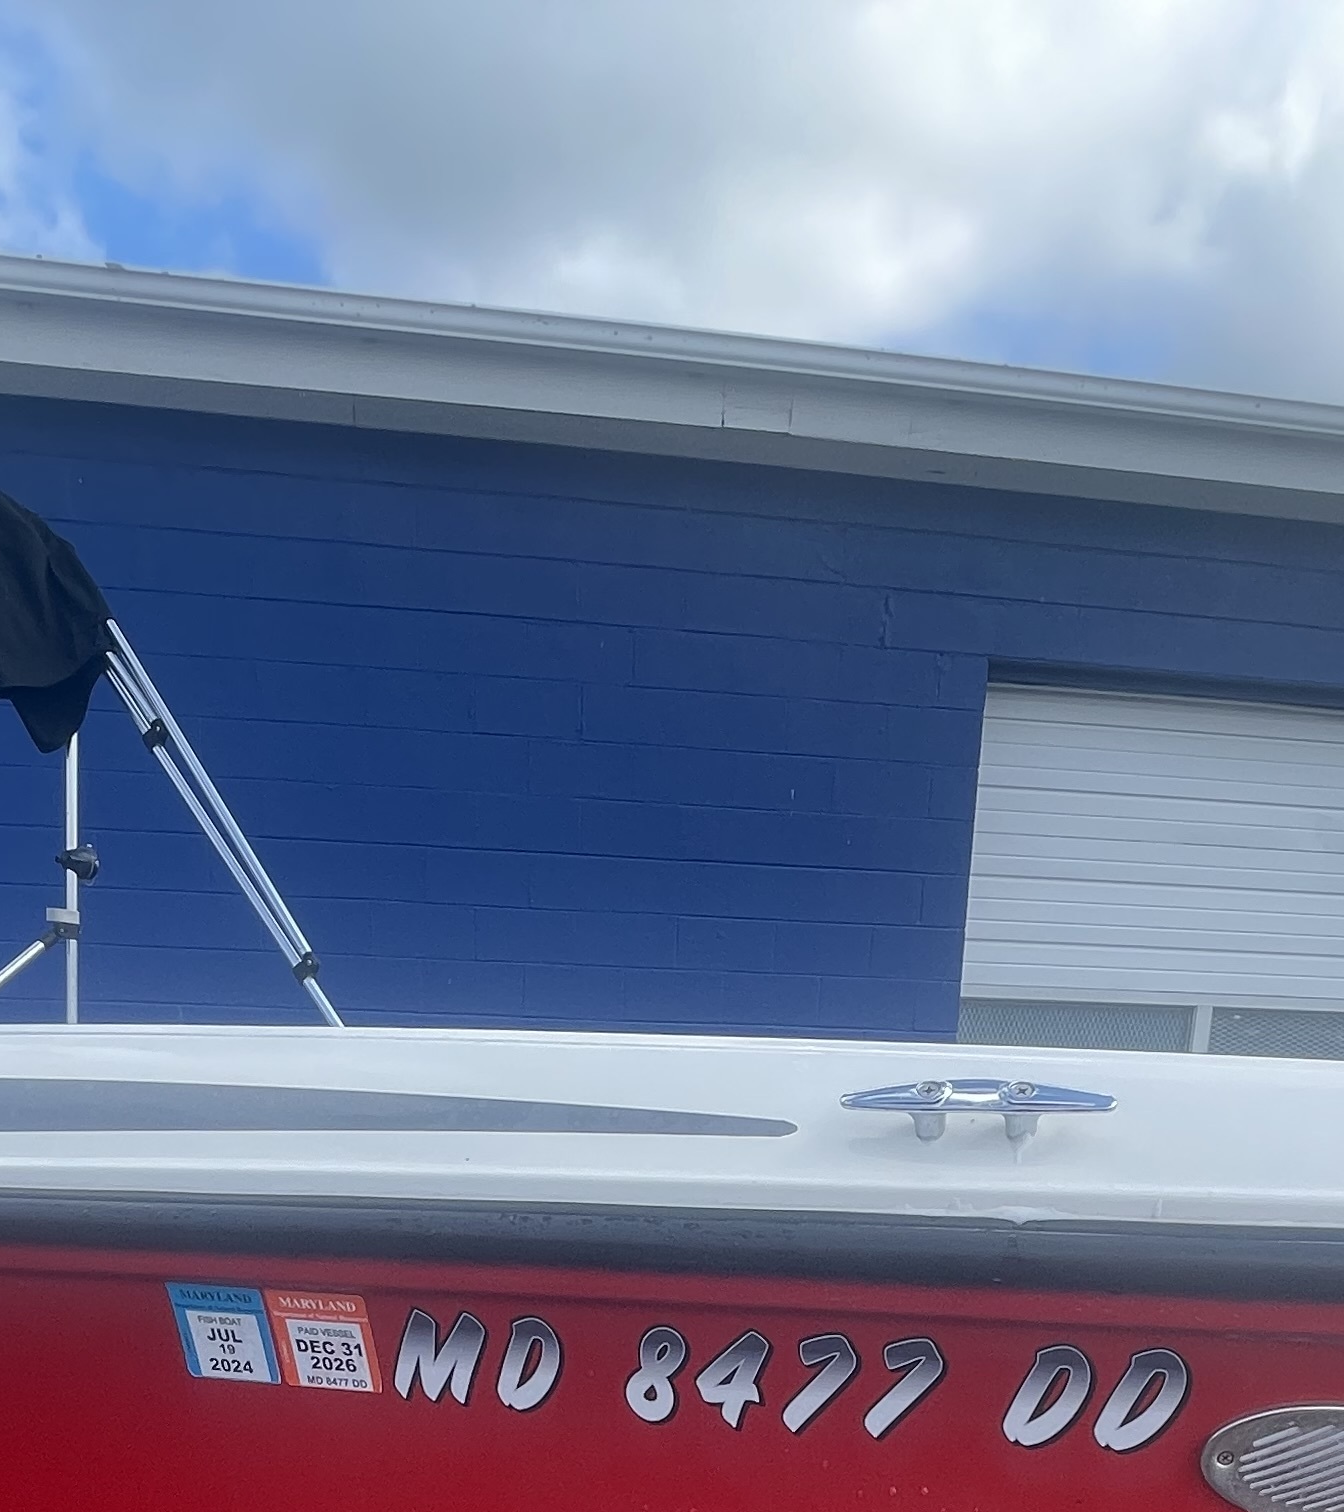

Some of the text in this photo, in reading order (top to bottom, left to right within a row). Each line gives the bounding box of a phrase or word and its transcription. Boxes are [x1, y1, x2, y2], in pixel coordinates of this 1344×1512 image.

[179, 1290, 252, 1303] MARYLAND
[278, 1297, 357, 1312] MARYLAND
[197, 1315, 242, 1326] FISH BOAT
[207, 1328, 243, 1343] JUL
[297, 1326, 356, 1339] PAID VESSEL
[219, 1344, 235, 1354] 19
[296, 1339, 336, 1355] DEC
[340, 1342, 364, 1357] 31
[209, 1358, 254, 1374] 2024
[310, 1356, 357, 1373] 2026
[307, 1375, 368, 1389] MD 8477 DD
[394, 1308, 1190, 1453] MD 8477 DD
